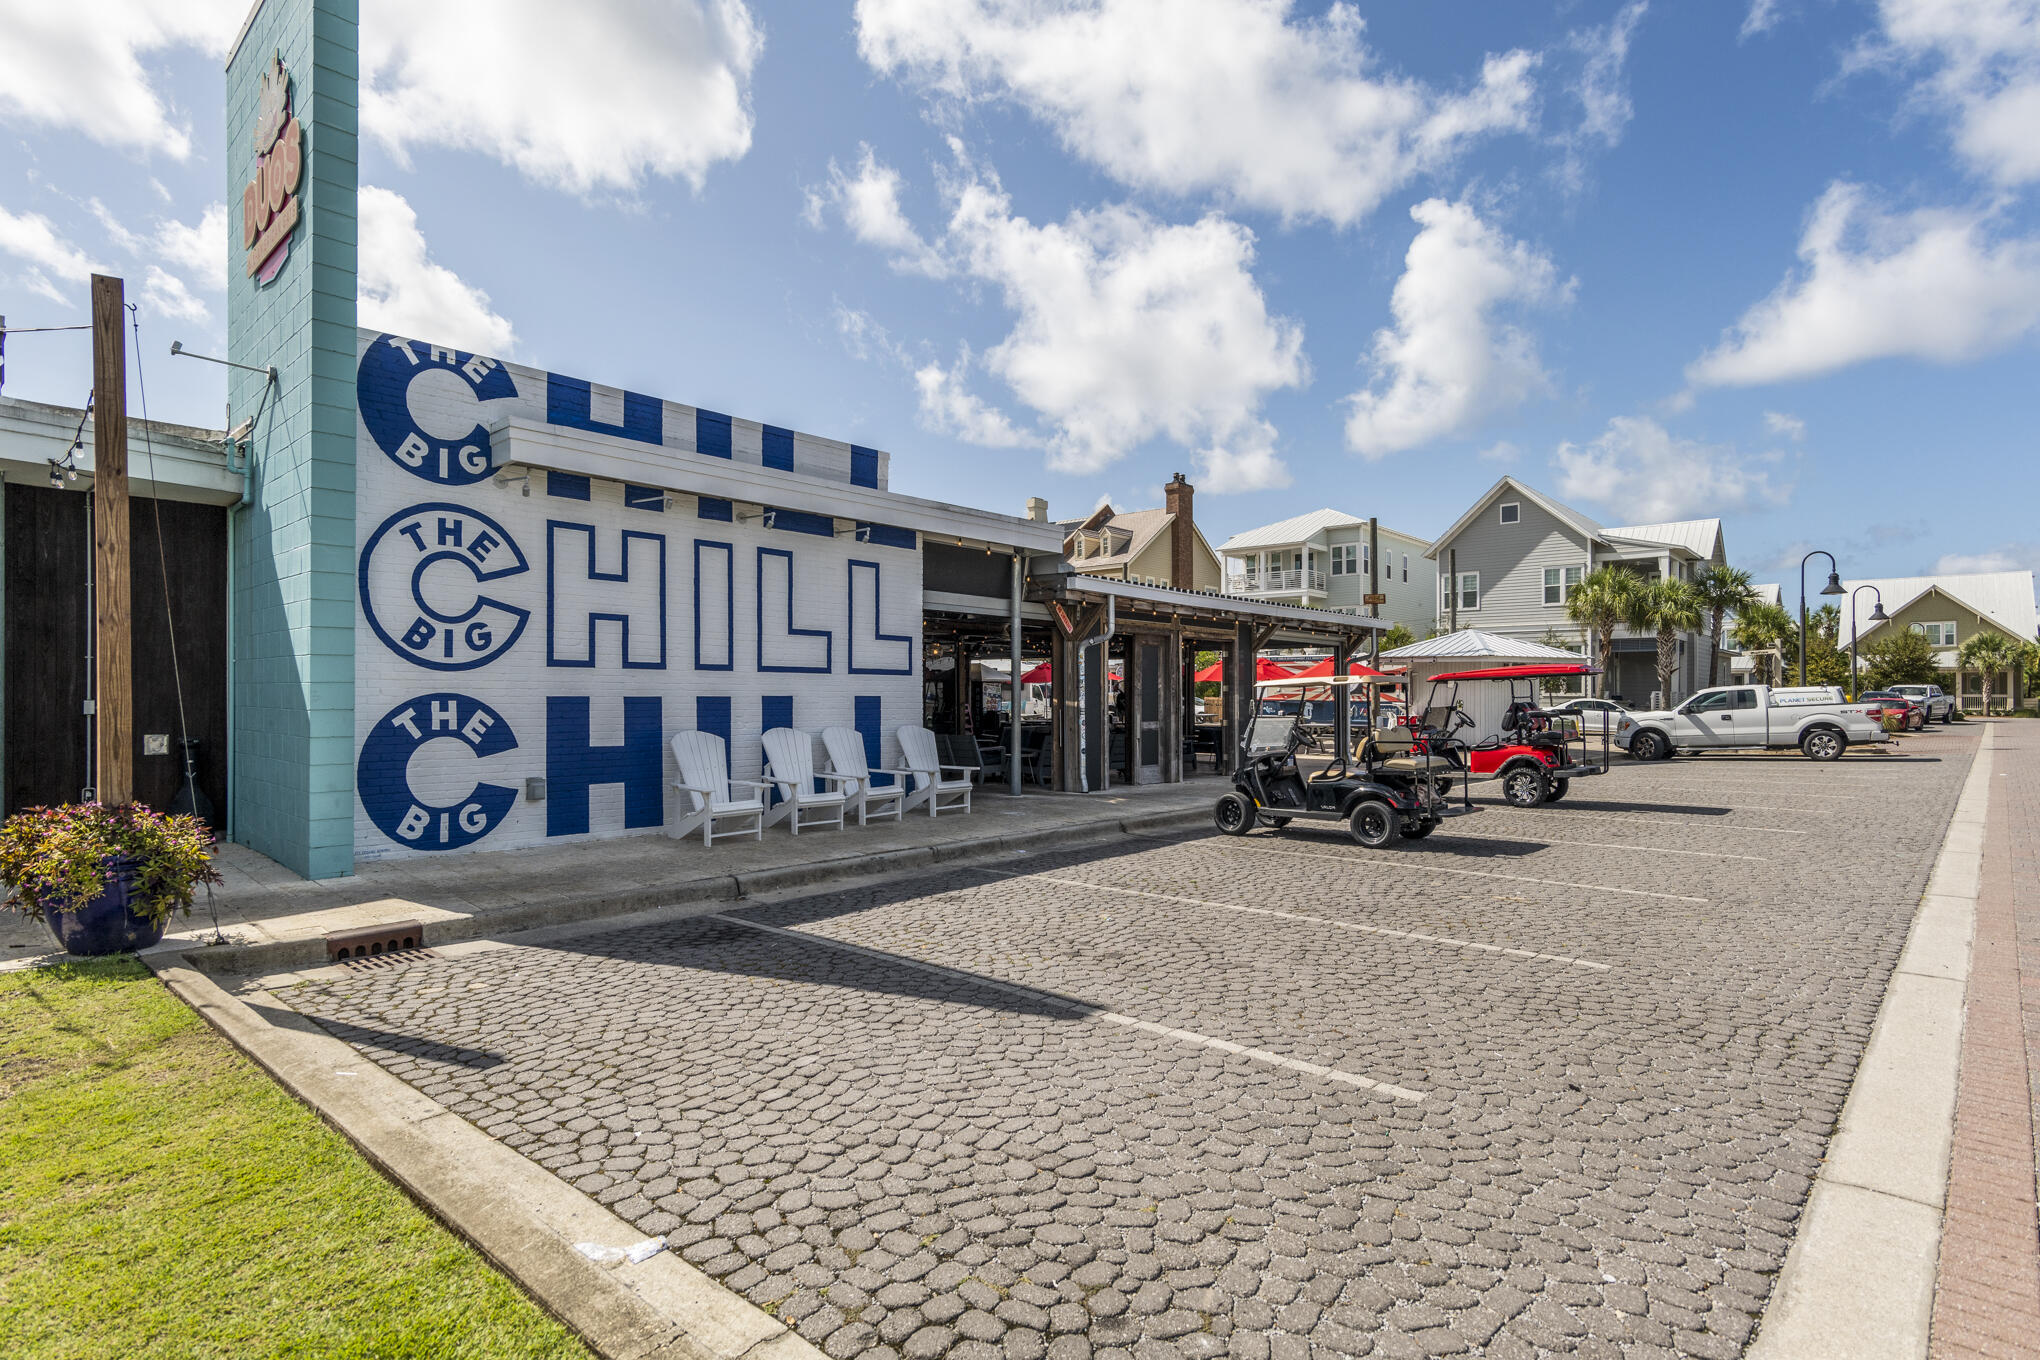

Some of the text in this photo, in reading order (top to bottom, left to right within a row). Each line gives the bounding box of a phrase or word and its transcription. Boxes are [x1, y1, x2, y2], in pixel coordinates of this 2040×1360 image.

[244, 117, 301, 251] DUOS
[388, 336, 497, 384] THE
[395, 432, 488, 479] BIG
[399, 517, 500, 563] THE
[358, 501, 913, 674] CHILL
[400, 616, 493, 658] BIG
[391, 700, 495, 745] THE
[357, 692, 914, 851] CHL
[396, 804, 487, 843] BIG
